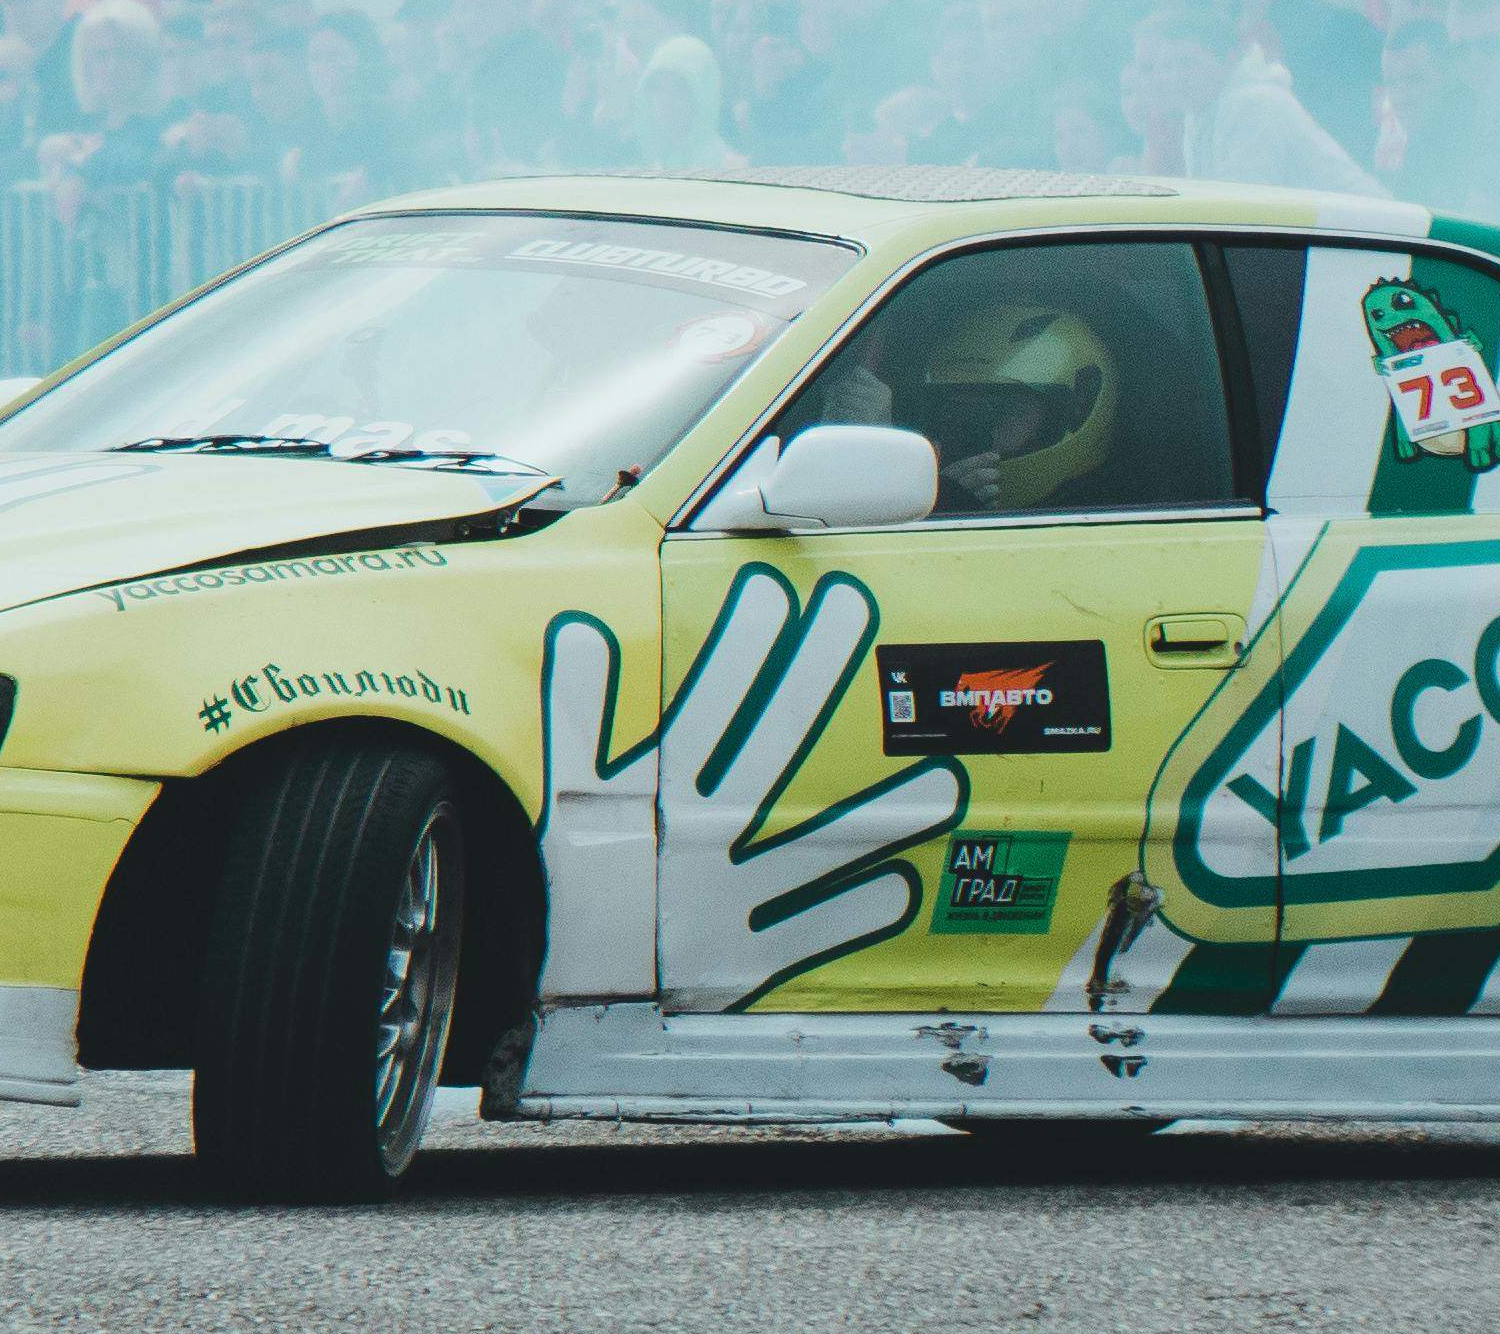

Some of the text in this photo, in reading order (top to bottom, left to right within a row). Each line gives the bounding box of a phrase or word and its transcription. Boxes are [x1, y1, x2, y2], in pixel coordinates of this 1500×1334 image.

[508, 240, 808, 297] CLUBTURBO
[1397, 367, 1486, 421] 73
[96, 548, 448, 612] yaccosamara.ru
[939, 688, 1053, 711] ВМПАВТО
[953, 844, 995, 870] АМ
[953, 877, 1019, 904] ГРАД
